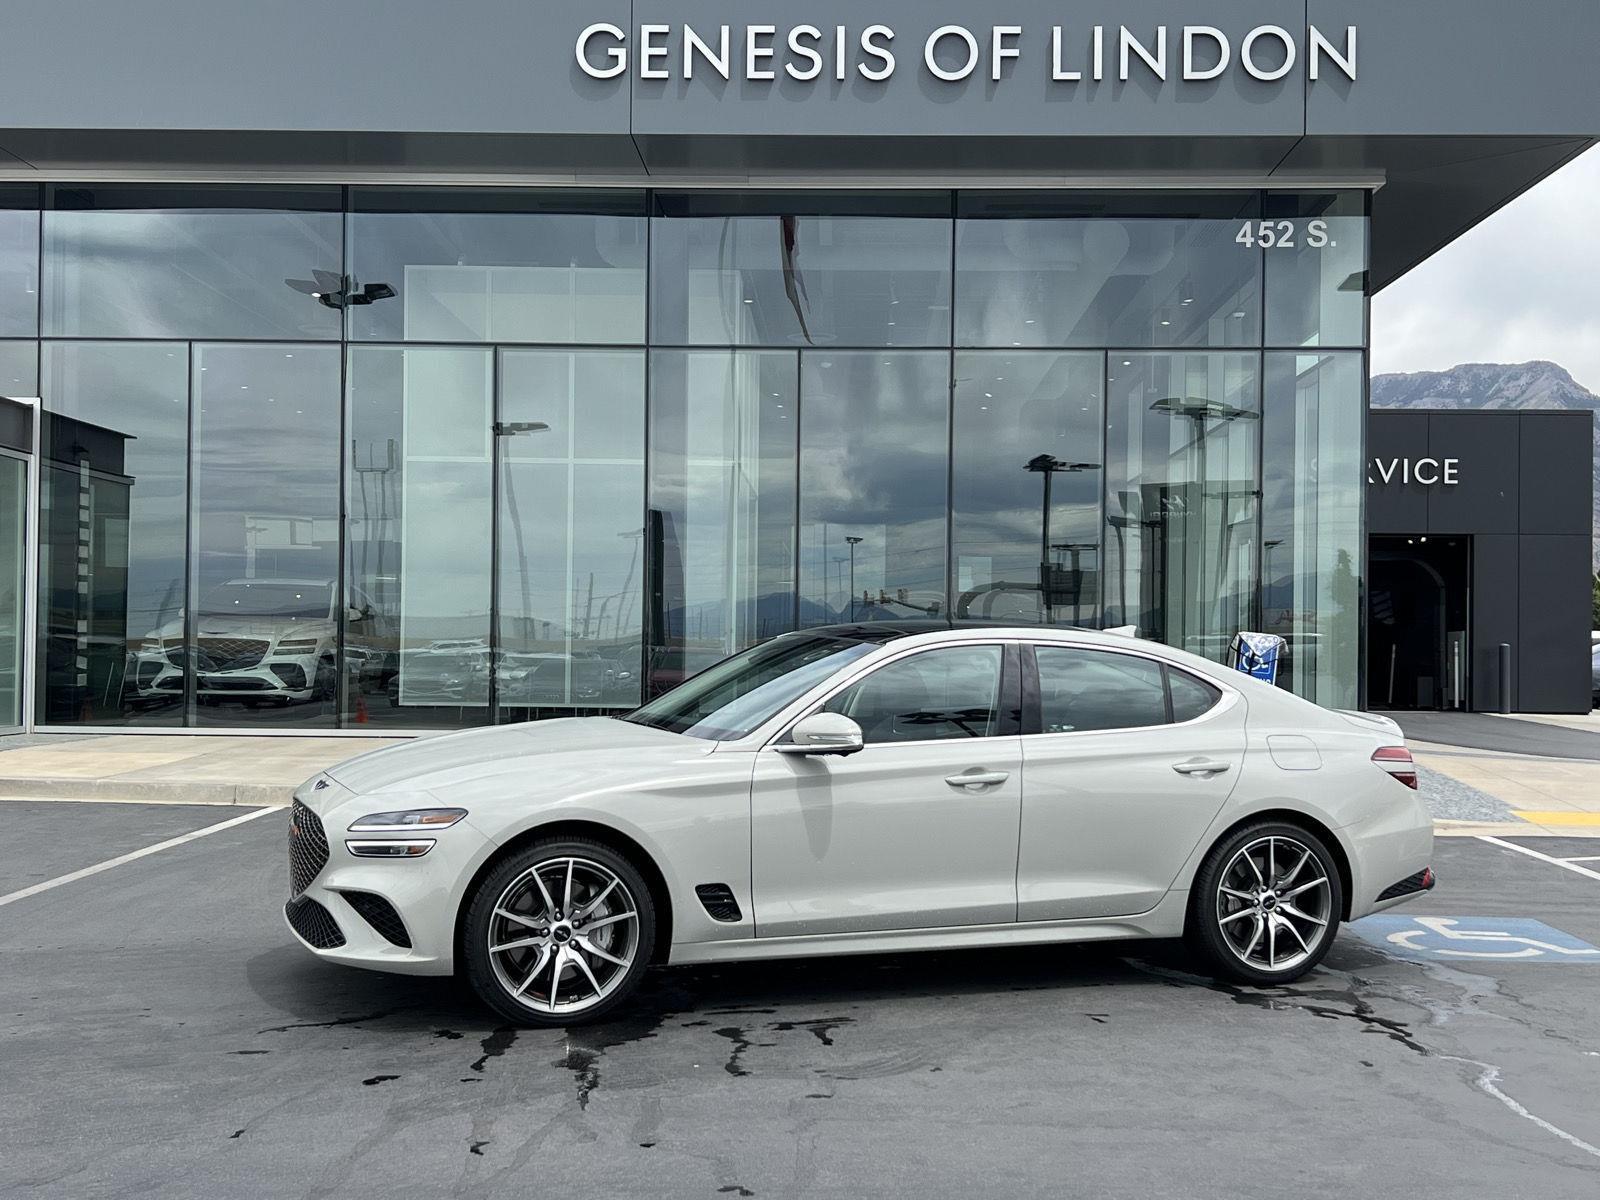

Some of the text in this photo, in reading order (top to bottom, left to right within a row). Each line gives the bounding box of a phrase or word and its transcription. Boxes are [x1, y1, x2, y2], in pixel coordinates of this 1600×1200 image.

[575, 22, 1358, 82] GENESIS OF LINDON
[1235, 219, 1337, 248] 452 S.
